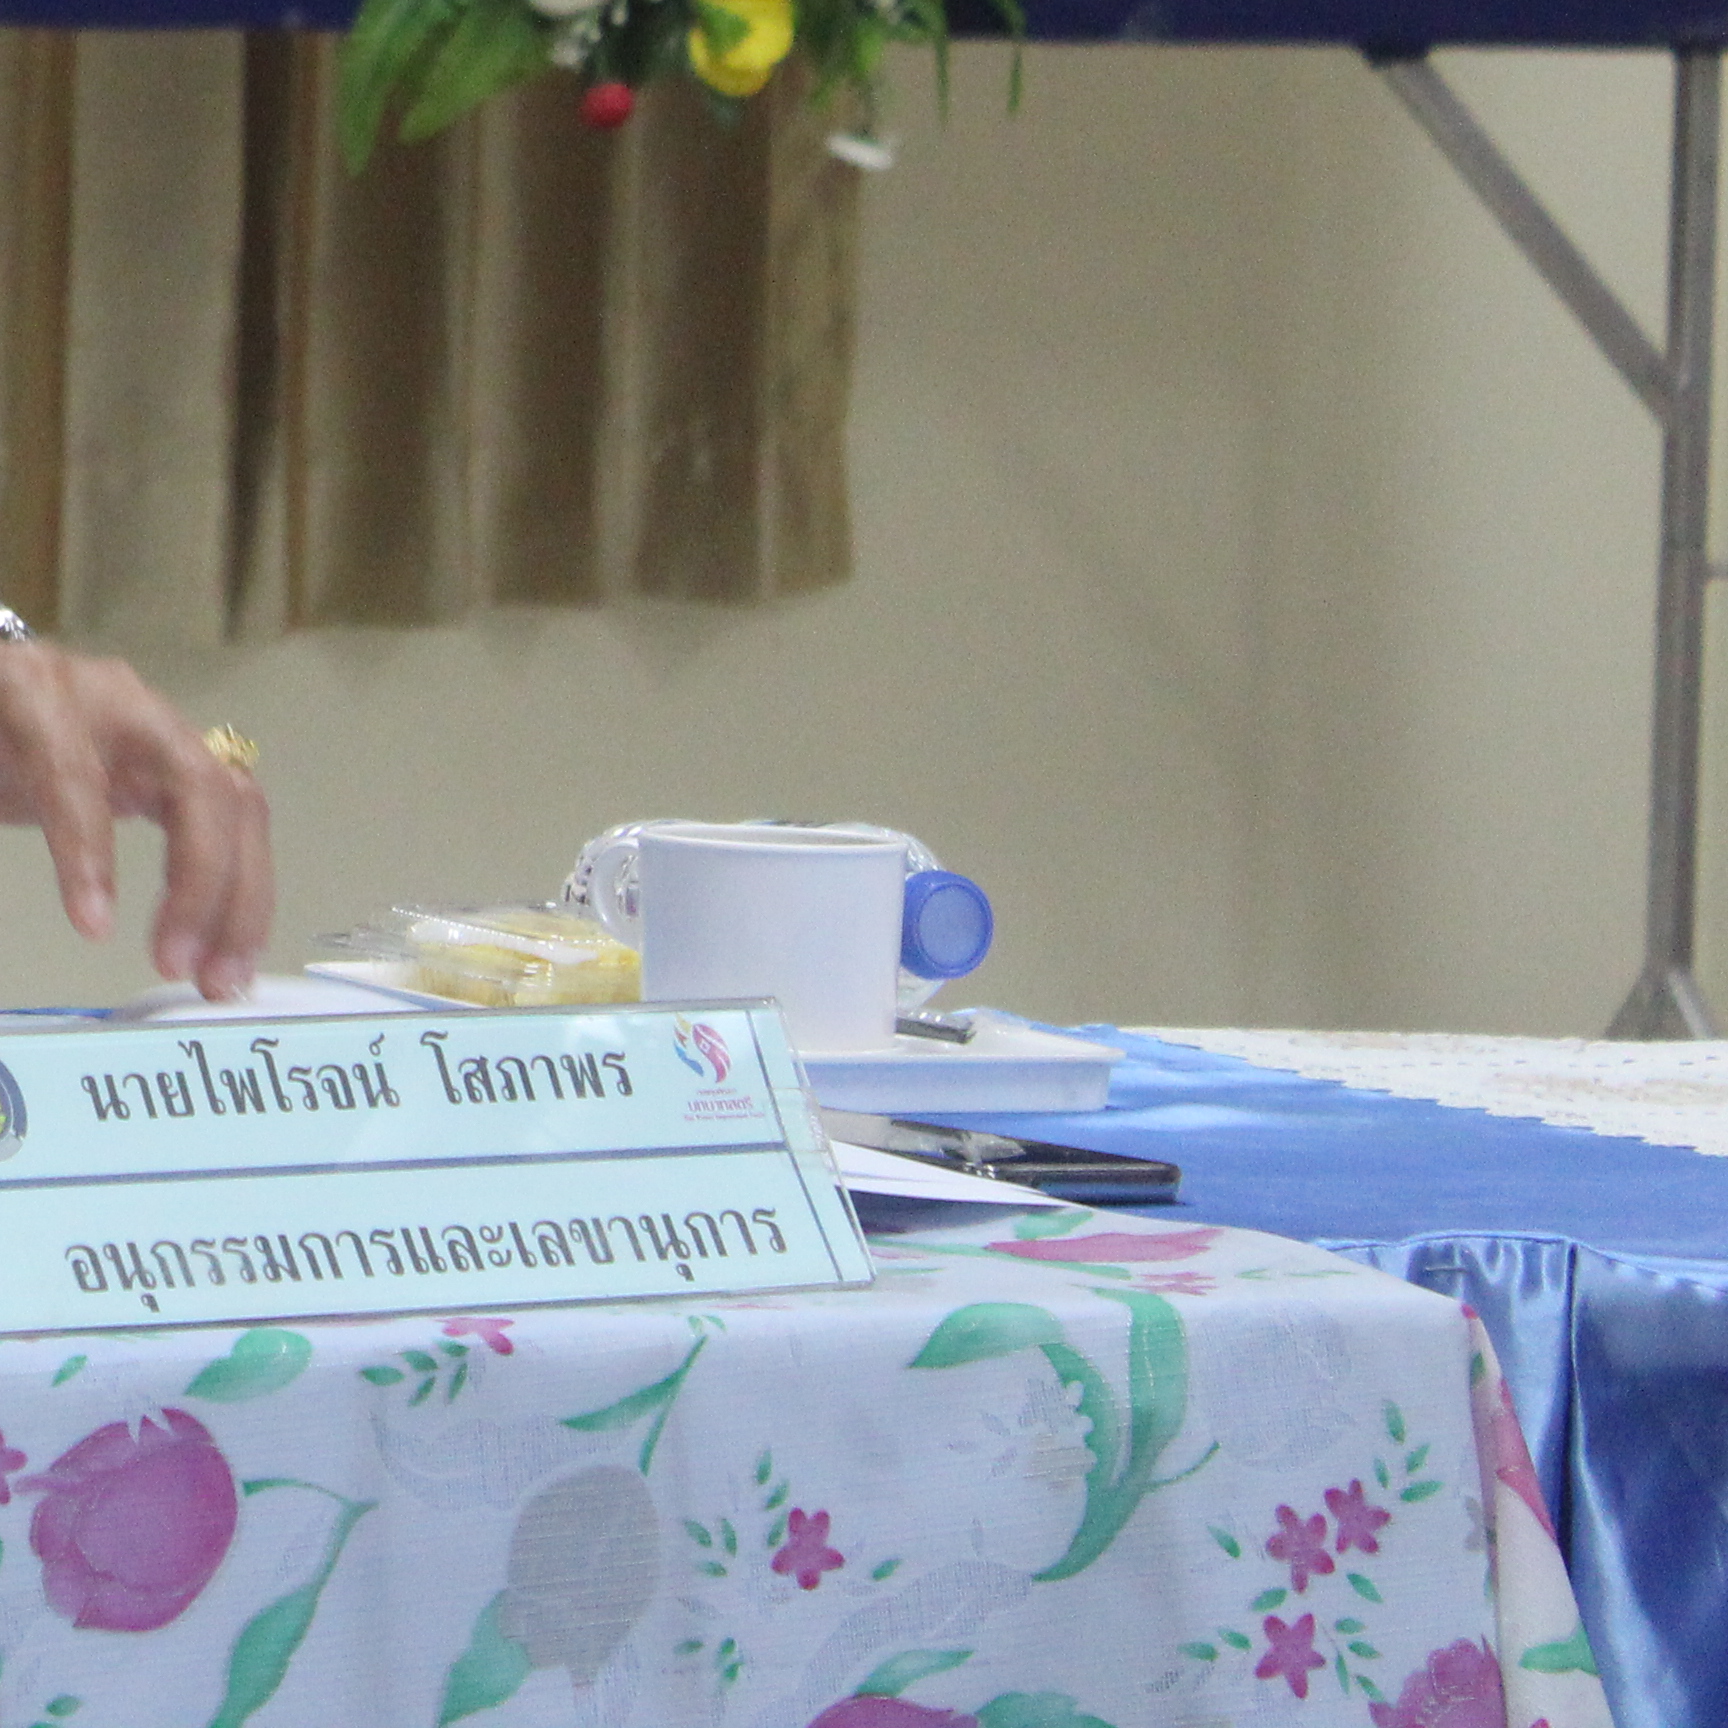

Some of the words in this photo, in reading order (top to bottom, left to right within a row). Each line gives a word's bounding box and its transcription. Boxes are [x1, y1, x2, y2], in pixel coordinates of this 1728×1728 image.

[81, 1034, 401, 1121] นายไพโรจน์
[421, 1030, 634, 1106] โสภาพร
[65, 1207, 788, 1313] อนุกรรมการและเลขานุการ
